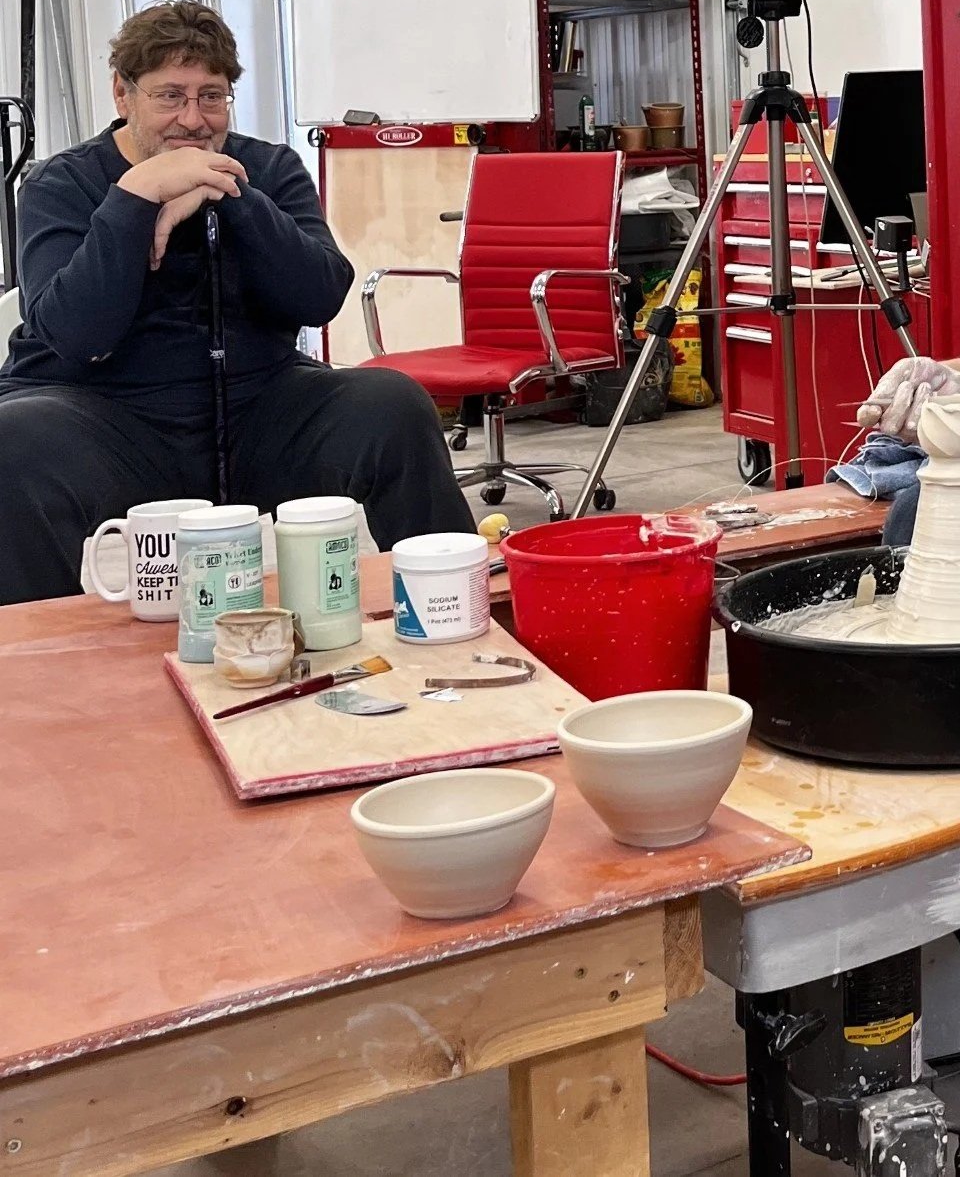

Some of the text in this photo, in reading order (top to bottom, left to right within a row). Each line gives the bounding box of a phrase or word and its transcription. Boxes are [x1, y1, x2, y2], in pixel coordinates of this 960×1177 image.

[135, 533, 176, 558] YOU'
[136, 561, 178, 575] Awes
[137, 576, 164, 588] KEEP
[137, 589, 173, 601] SHIT
[428, 595, 458, 604] SODIUM
[427, 603, 460, 613] SILICATE
